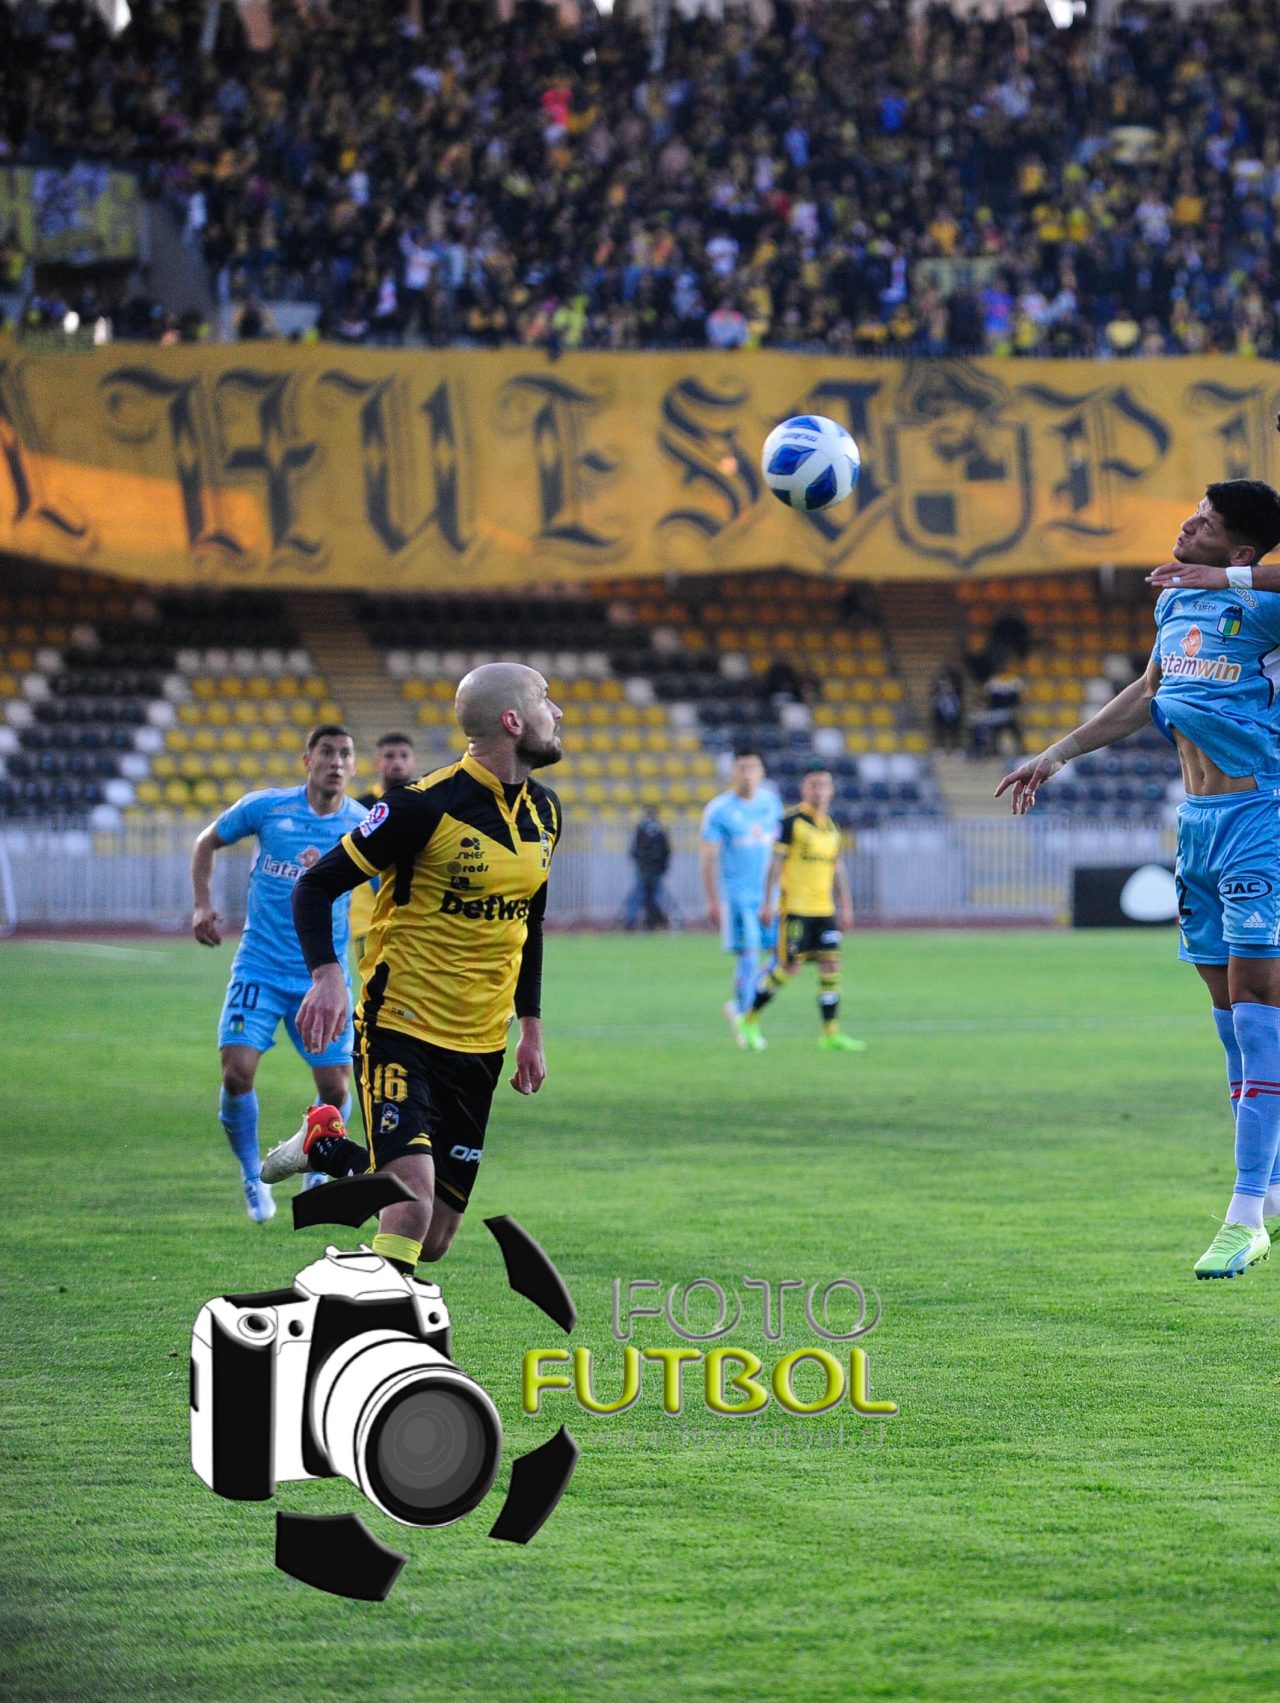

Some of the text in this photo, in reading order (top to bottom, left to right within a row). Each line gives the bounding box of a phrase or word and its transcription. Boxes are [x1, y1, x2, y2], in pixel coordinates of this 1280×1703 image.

[1161, 655, 1241, 683] atamwin
[1222, 881, 1262, 895] JAC
[439, 890, 530, 925] betwa
[227, 980, 260, 1010] 20
[373, 1062, 409, 1104] 16
